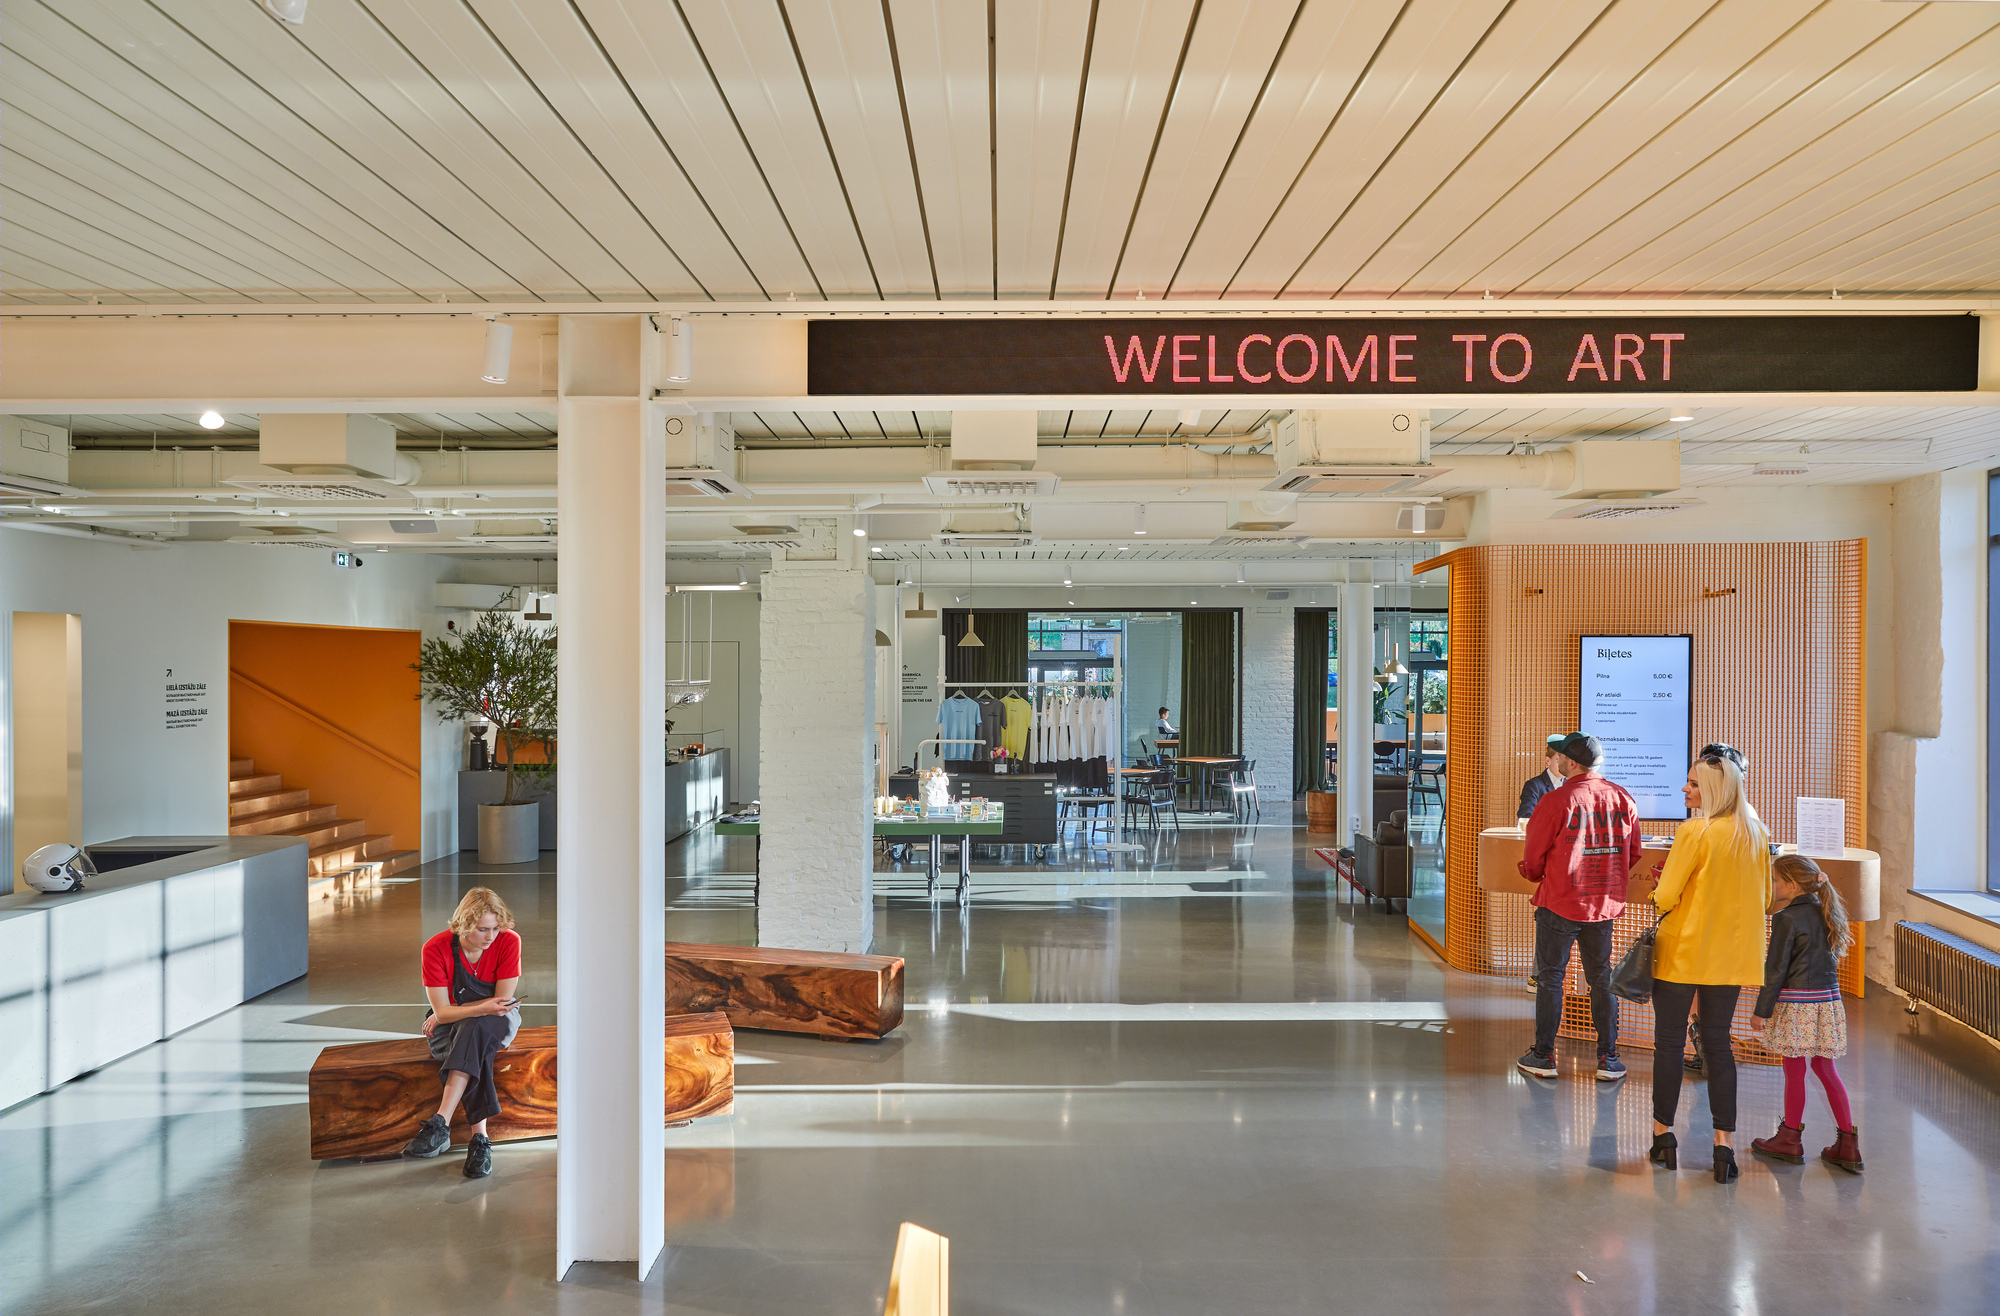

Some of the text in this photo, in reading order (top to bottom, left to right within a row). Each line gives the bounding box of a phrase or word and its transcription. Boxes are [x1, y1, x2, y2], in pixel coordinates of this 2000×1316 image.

[1104, 333, 1685, 384] WELCOME TO ART
[1597, 648, 1632, 660] Biļetes
[166, 683, 178, 692] LIELĀ
[166, 709, 179, 717] MAZĀ
[180, 708, 197, 716] IZSTĀŽU
[1582, 834, 1599, 844] 310
